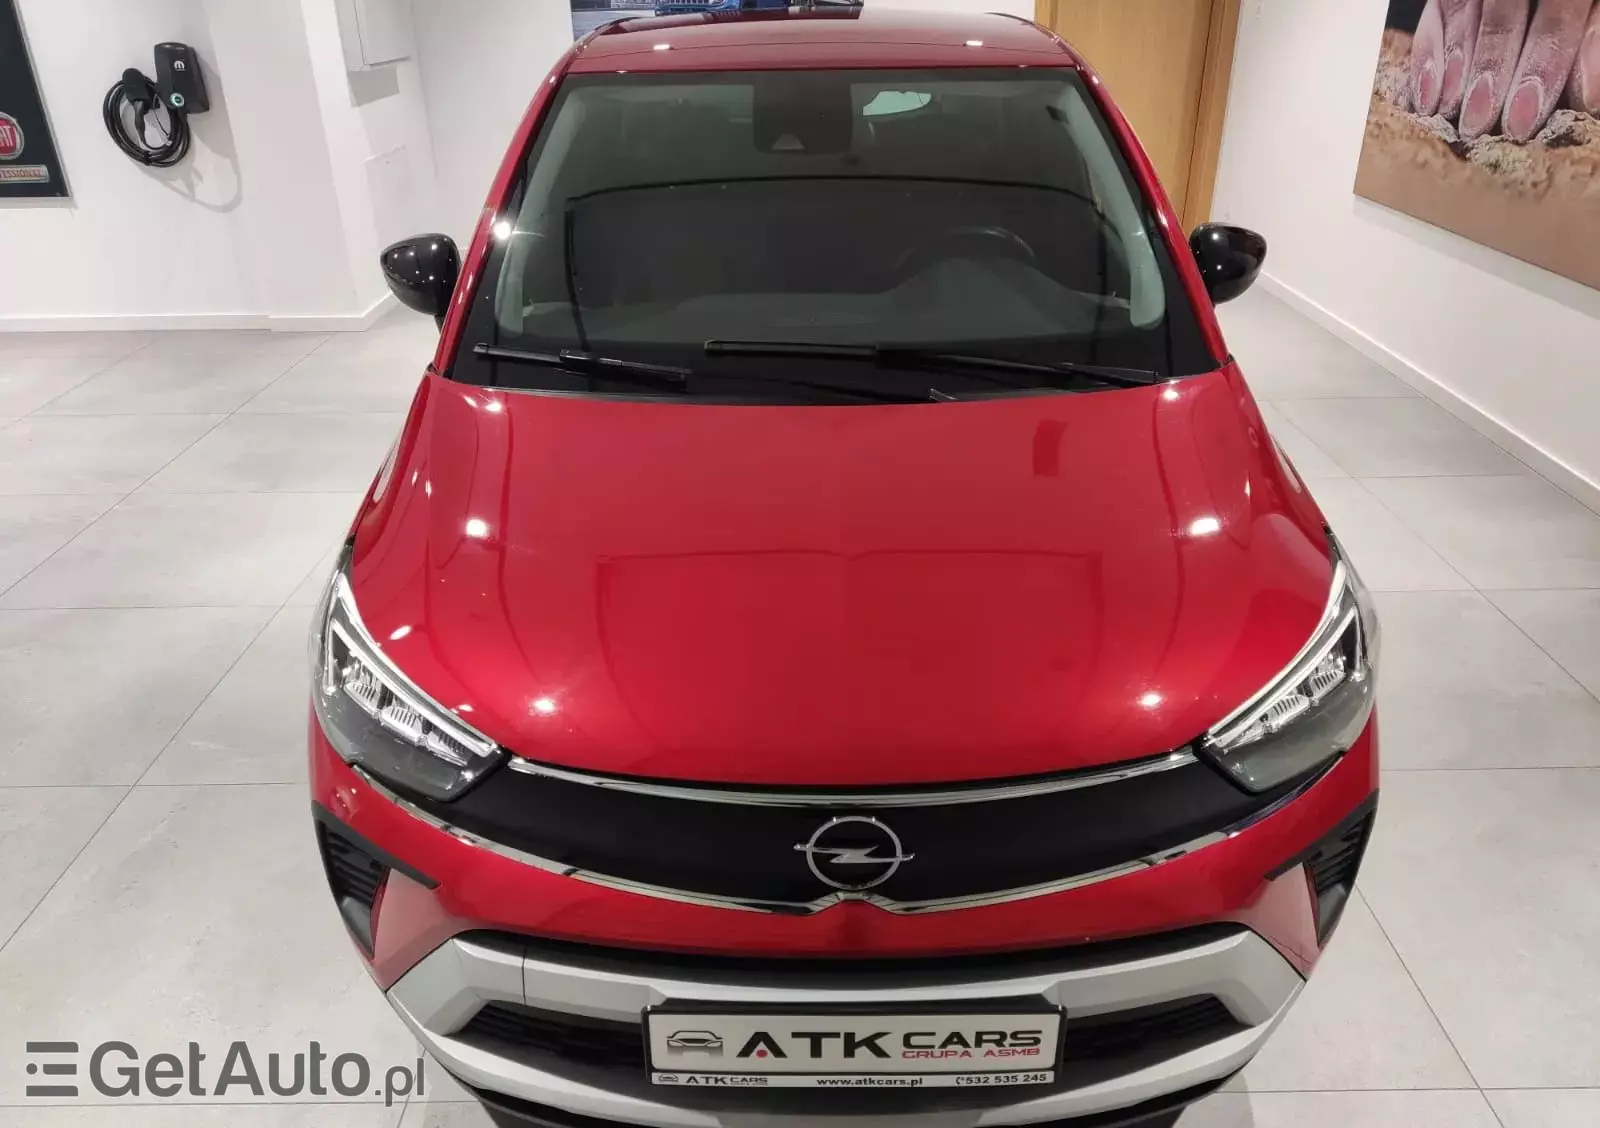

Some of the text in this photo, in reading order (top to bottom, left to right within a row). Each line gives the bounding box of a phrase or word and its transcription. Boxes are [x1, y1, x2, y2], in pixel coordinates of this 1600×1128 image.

[736, 1030, 1043, 1058] ATK CARS
[902, 1048, 1041, 1059] GRUPA ASMB
[686, 1076, 729, 1085] ATK
[817, 1076, 923, 1086] www.atkcars.pl
[994, 1075, 1018, 1083] 535
[1023, 1073, 1047, 1082] 245
